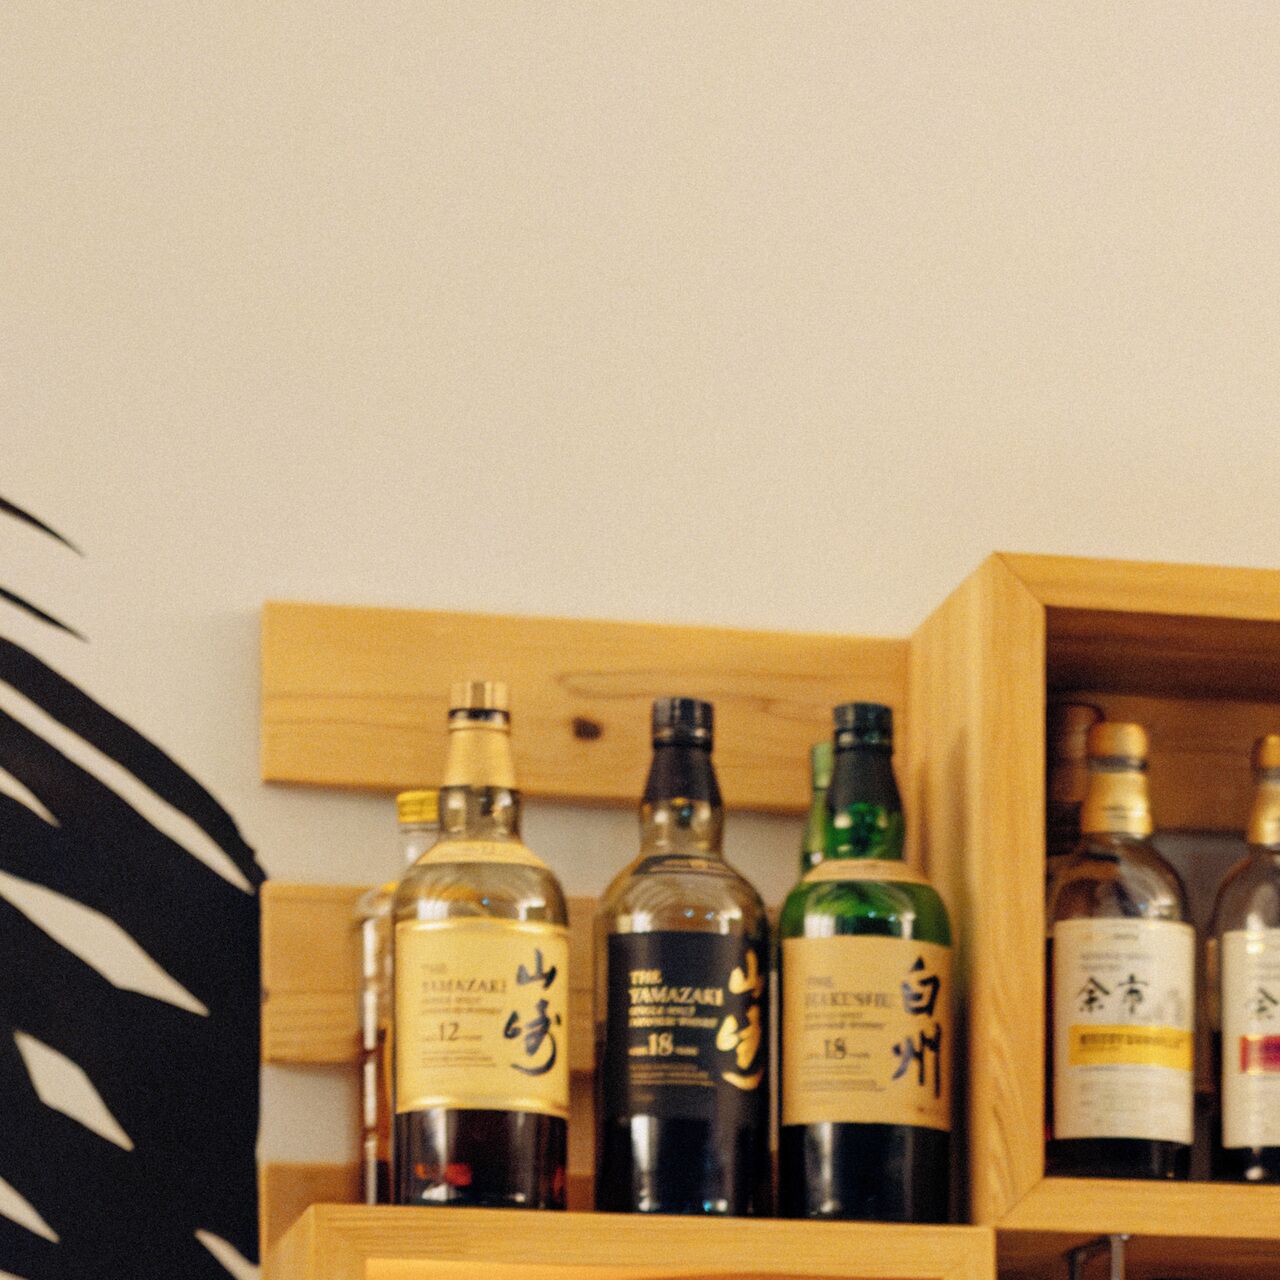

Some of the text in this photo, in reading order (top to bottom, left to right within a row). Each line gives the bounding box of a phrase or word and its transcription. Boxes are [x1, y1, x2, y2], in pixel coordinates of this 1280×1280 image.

[628, 986, 724, 1007] YAMAZAKI
[1077, 973, 1149, 1014] 余市
[648, 1033, 674, 1056] 18
